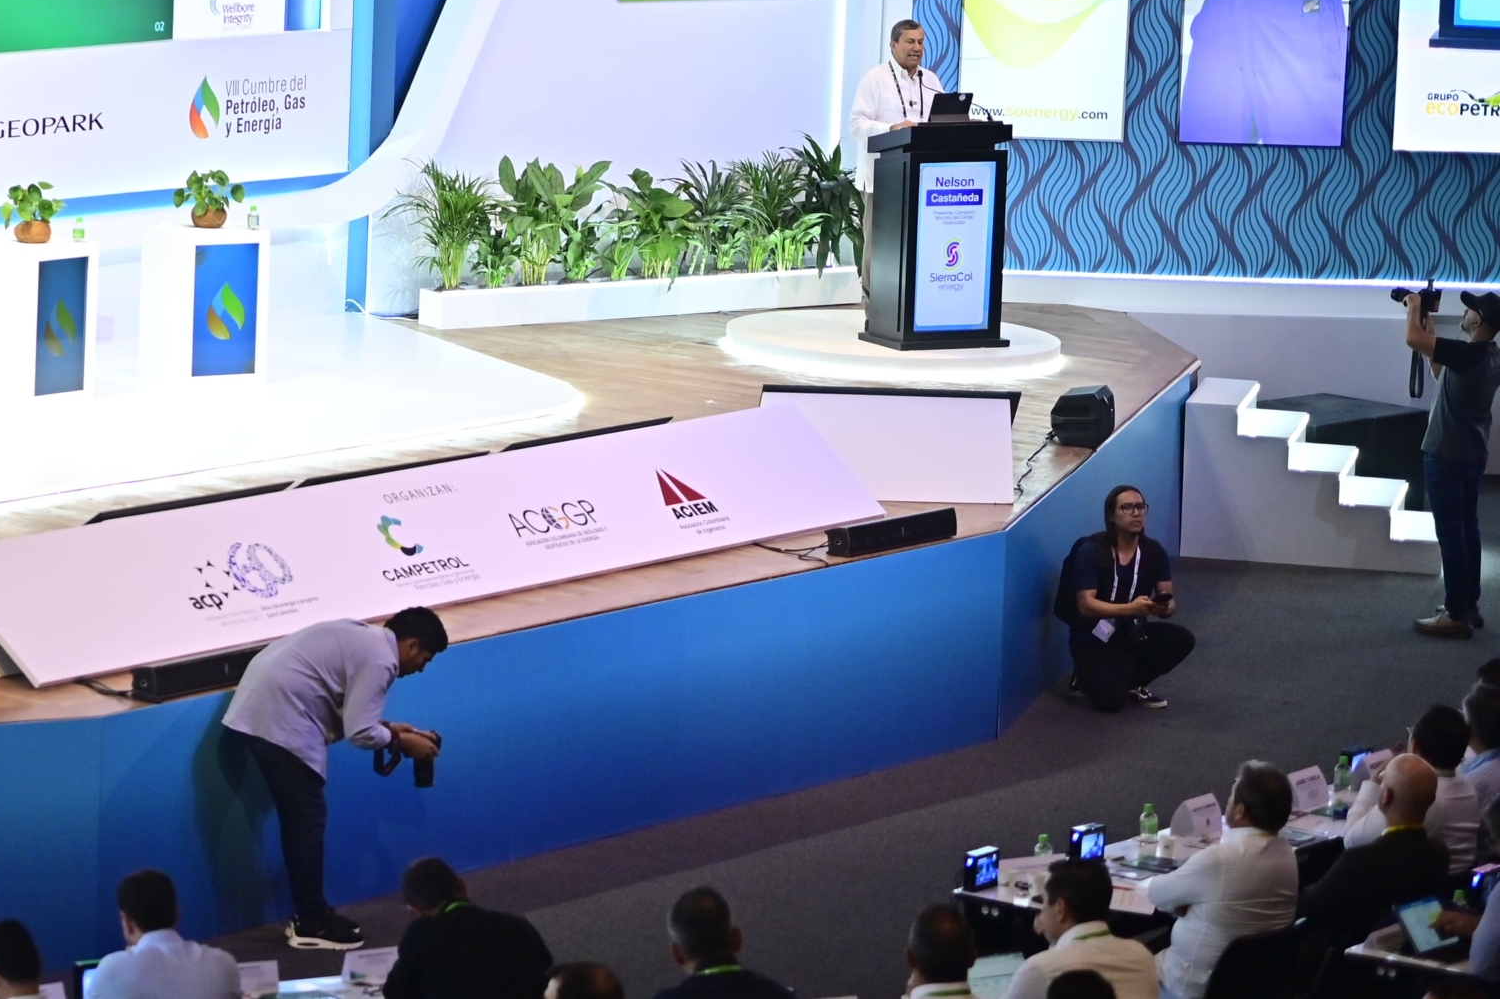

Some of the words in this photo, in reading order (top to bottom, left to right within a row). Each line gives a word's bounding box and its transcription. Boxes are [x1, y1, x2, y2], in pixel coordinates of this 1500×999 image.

[222, 2, 255, 13] Wellbore
[223, 14, 253, 26] Integrity
[155, 22, 165, 32] 02
[225, 80, 240, 97] VIII
[242, 78, 287, 97] Cumbre
[290, 74, 307, 91] del
[1427, 93, 1459, 101] GRUPO
[225, 95, 280, 118] Petróleo,
[285, 93, 306, 110] Gas
[226, 121, 233, 138] y
[236, 113, 282, 136] Energía
[935, 176, 975, 187] Nelson
[931, 193, 980, 203] Castañeda
[930, 272, 973, 282] SierraCol
[938, 283, 964, 291] energy
[383, 483, 457, 504] ORGANIZAN:
[671, 500, 719, 520] ACIEM
[382, 556, 469, 581] CAMPETROL
[188, 593, 224, 610] acp
